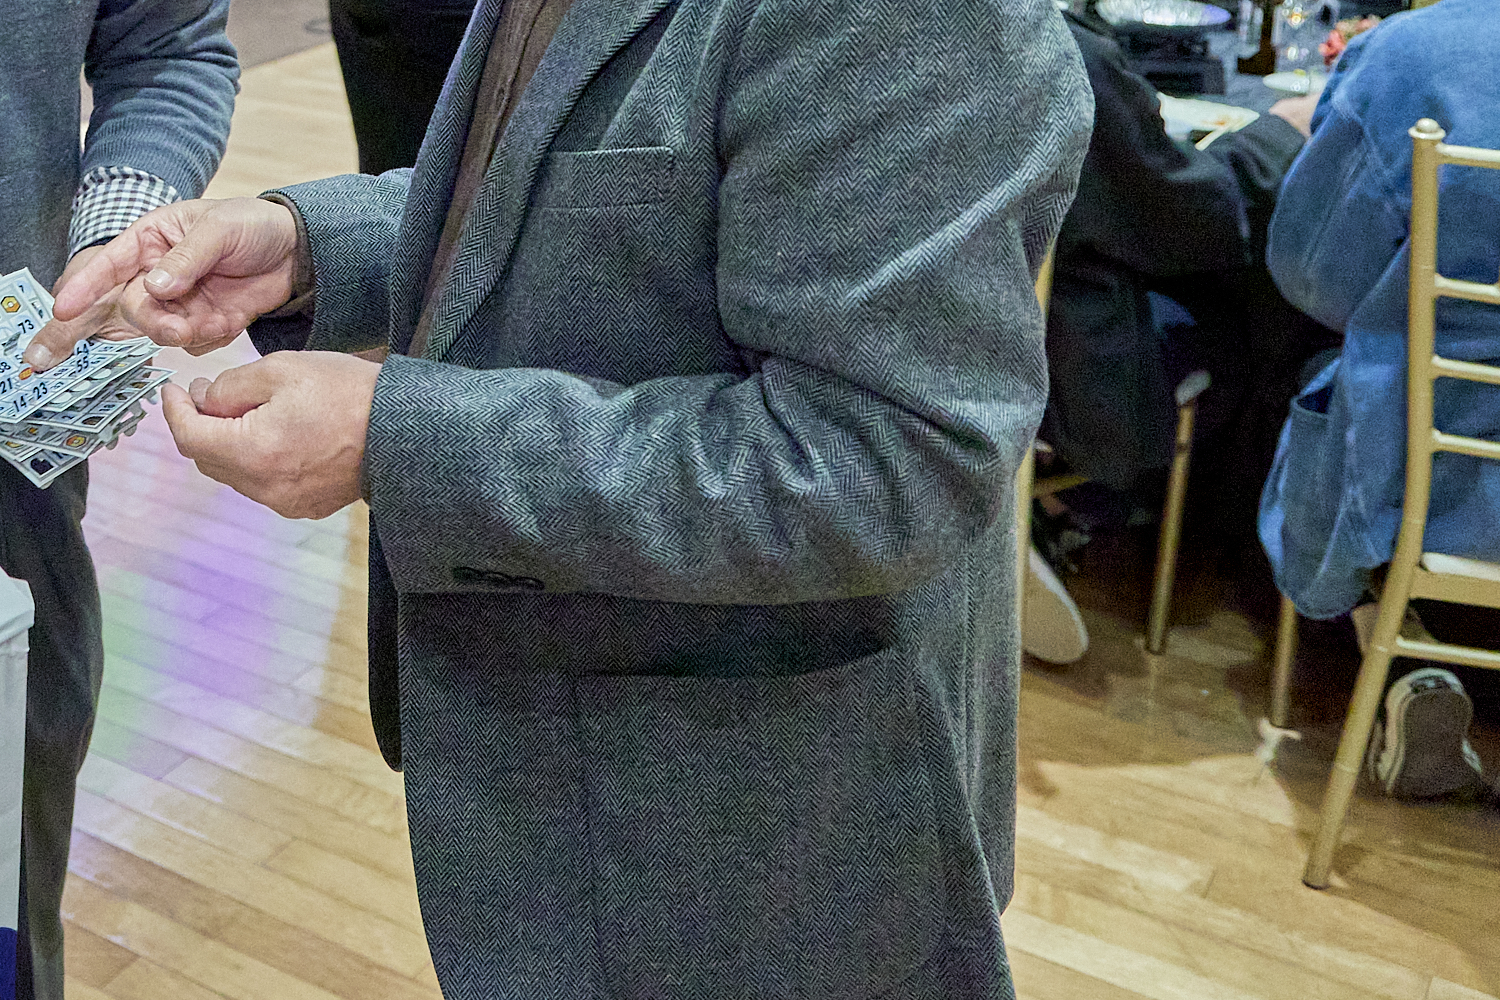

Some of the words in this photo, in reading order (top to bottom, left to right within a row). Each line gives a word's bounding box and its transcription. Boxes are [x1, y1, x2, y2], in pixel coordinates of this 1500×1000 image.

[17, 319, 35, 334] 73
[0, 378, 13, 394] 21
[13, 396, 27, 412] 14
[33, 382, 48, 399] 23
[76, 355, 90, 373] 55
